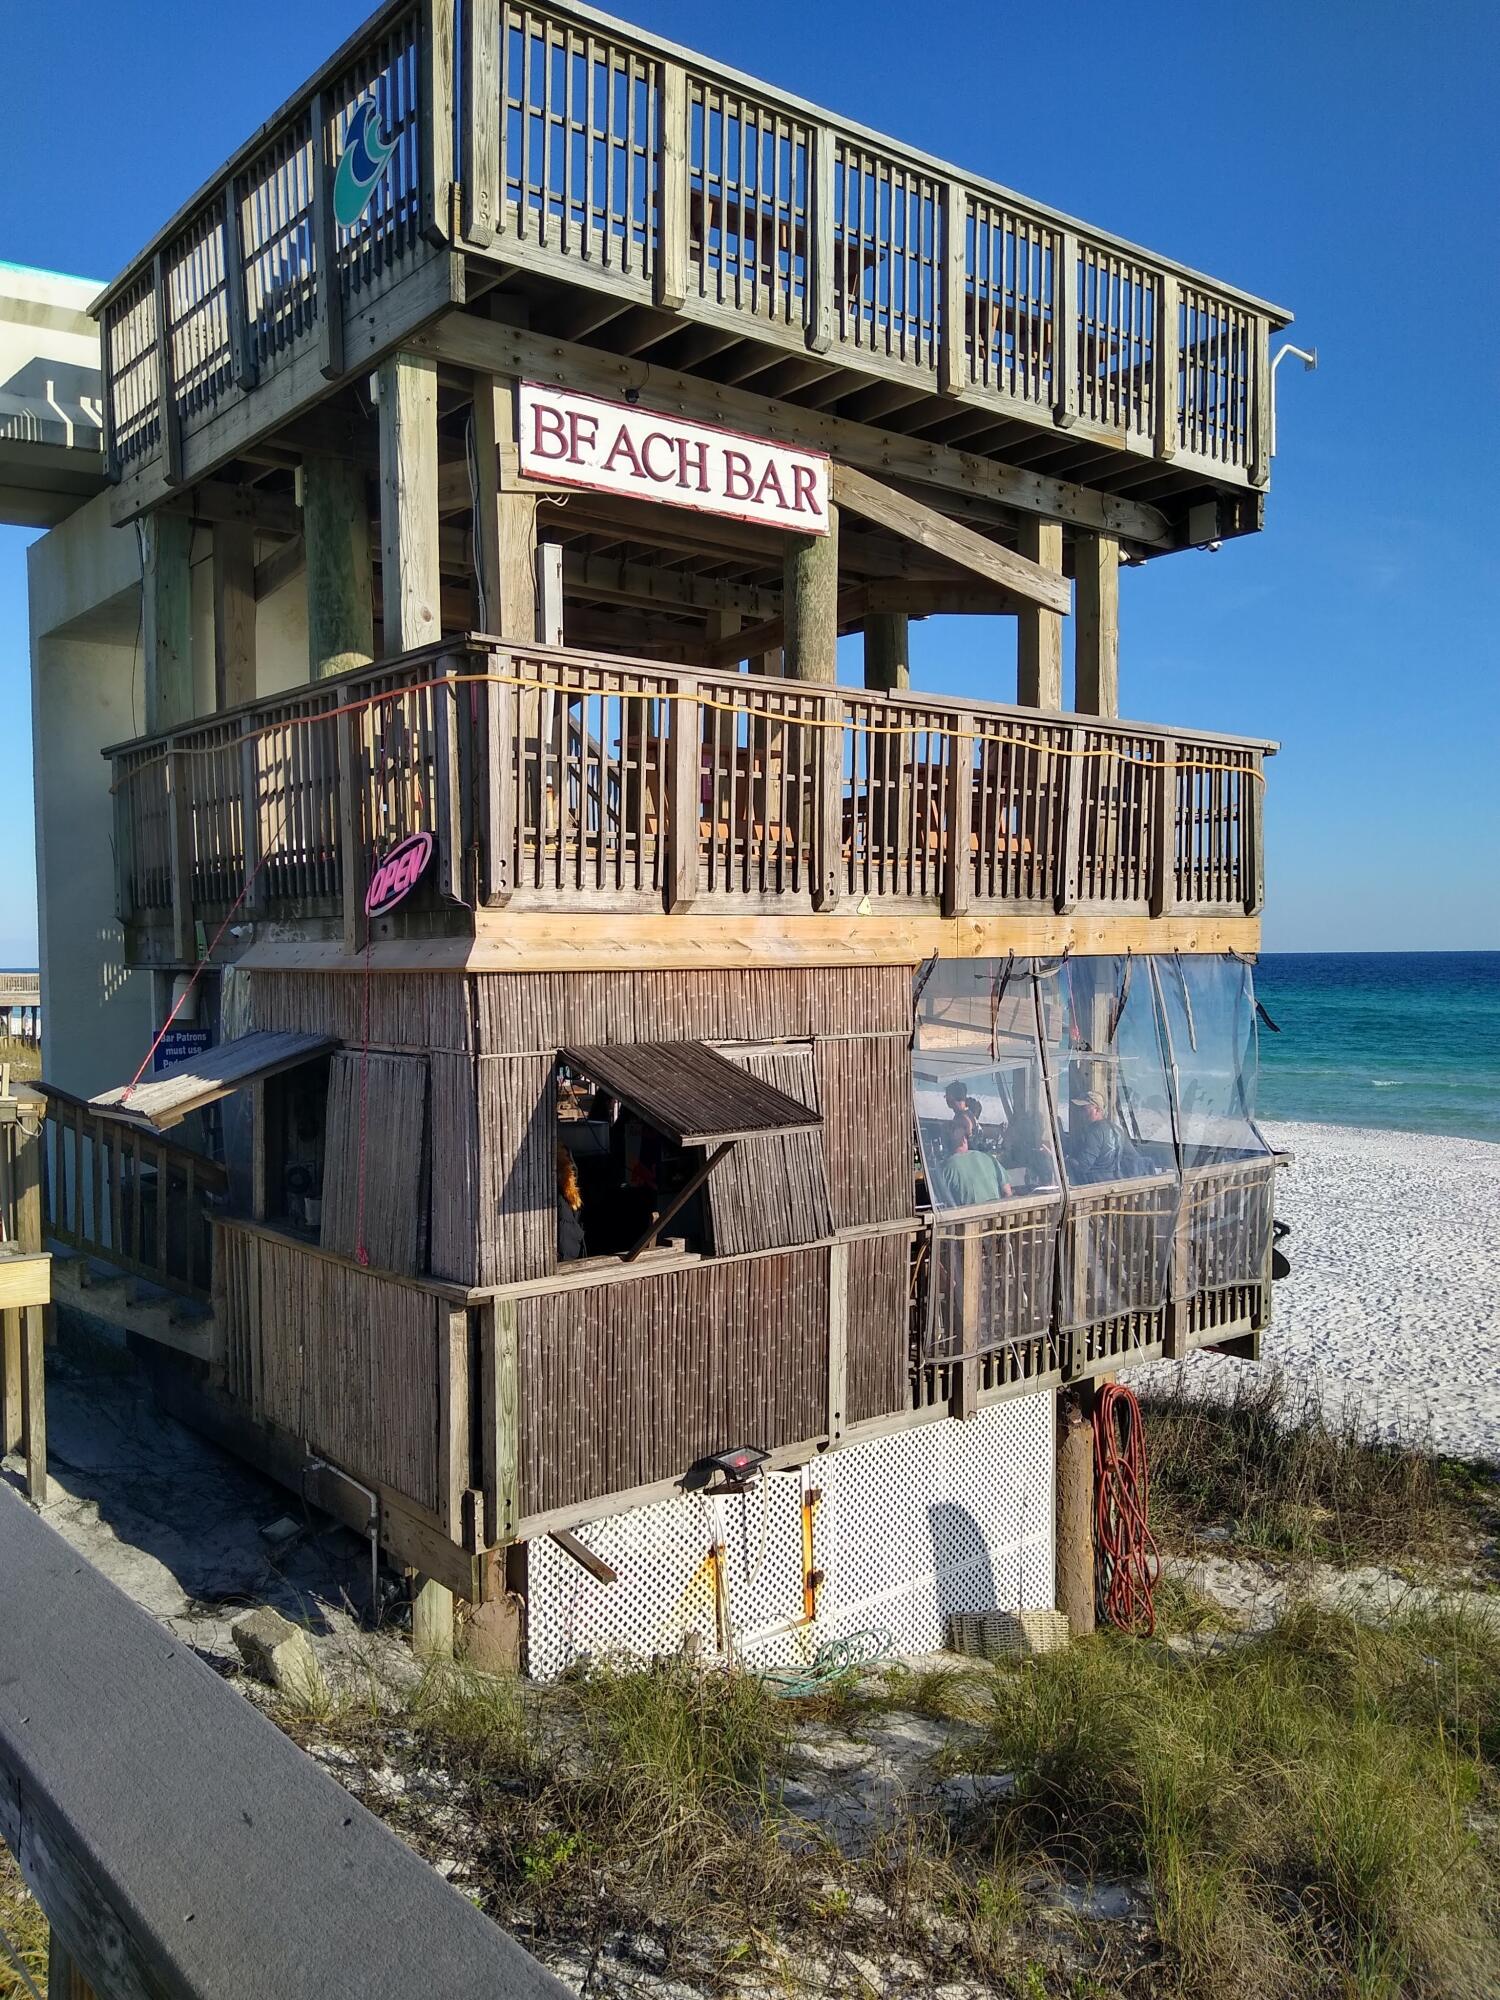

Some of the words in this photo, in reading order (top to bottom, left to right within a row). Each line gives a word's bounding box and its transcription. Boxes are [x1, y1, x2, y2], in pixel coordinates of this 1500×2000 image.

[722, 449, 823, 515] BAR
[369, 842, 426, 906] OPEN
[165, 1046, 186, 1056] must
[187, 1046, 202, 1054] use
[176, 1032, 207, 1042] Patrons
